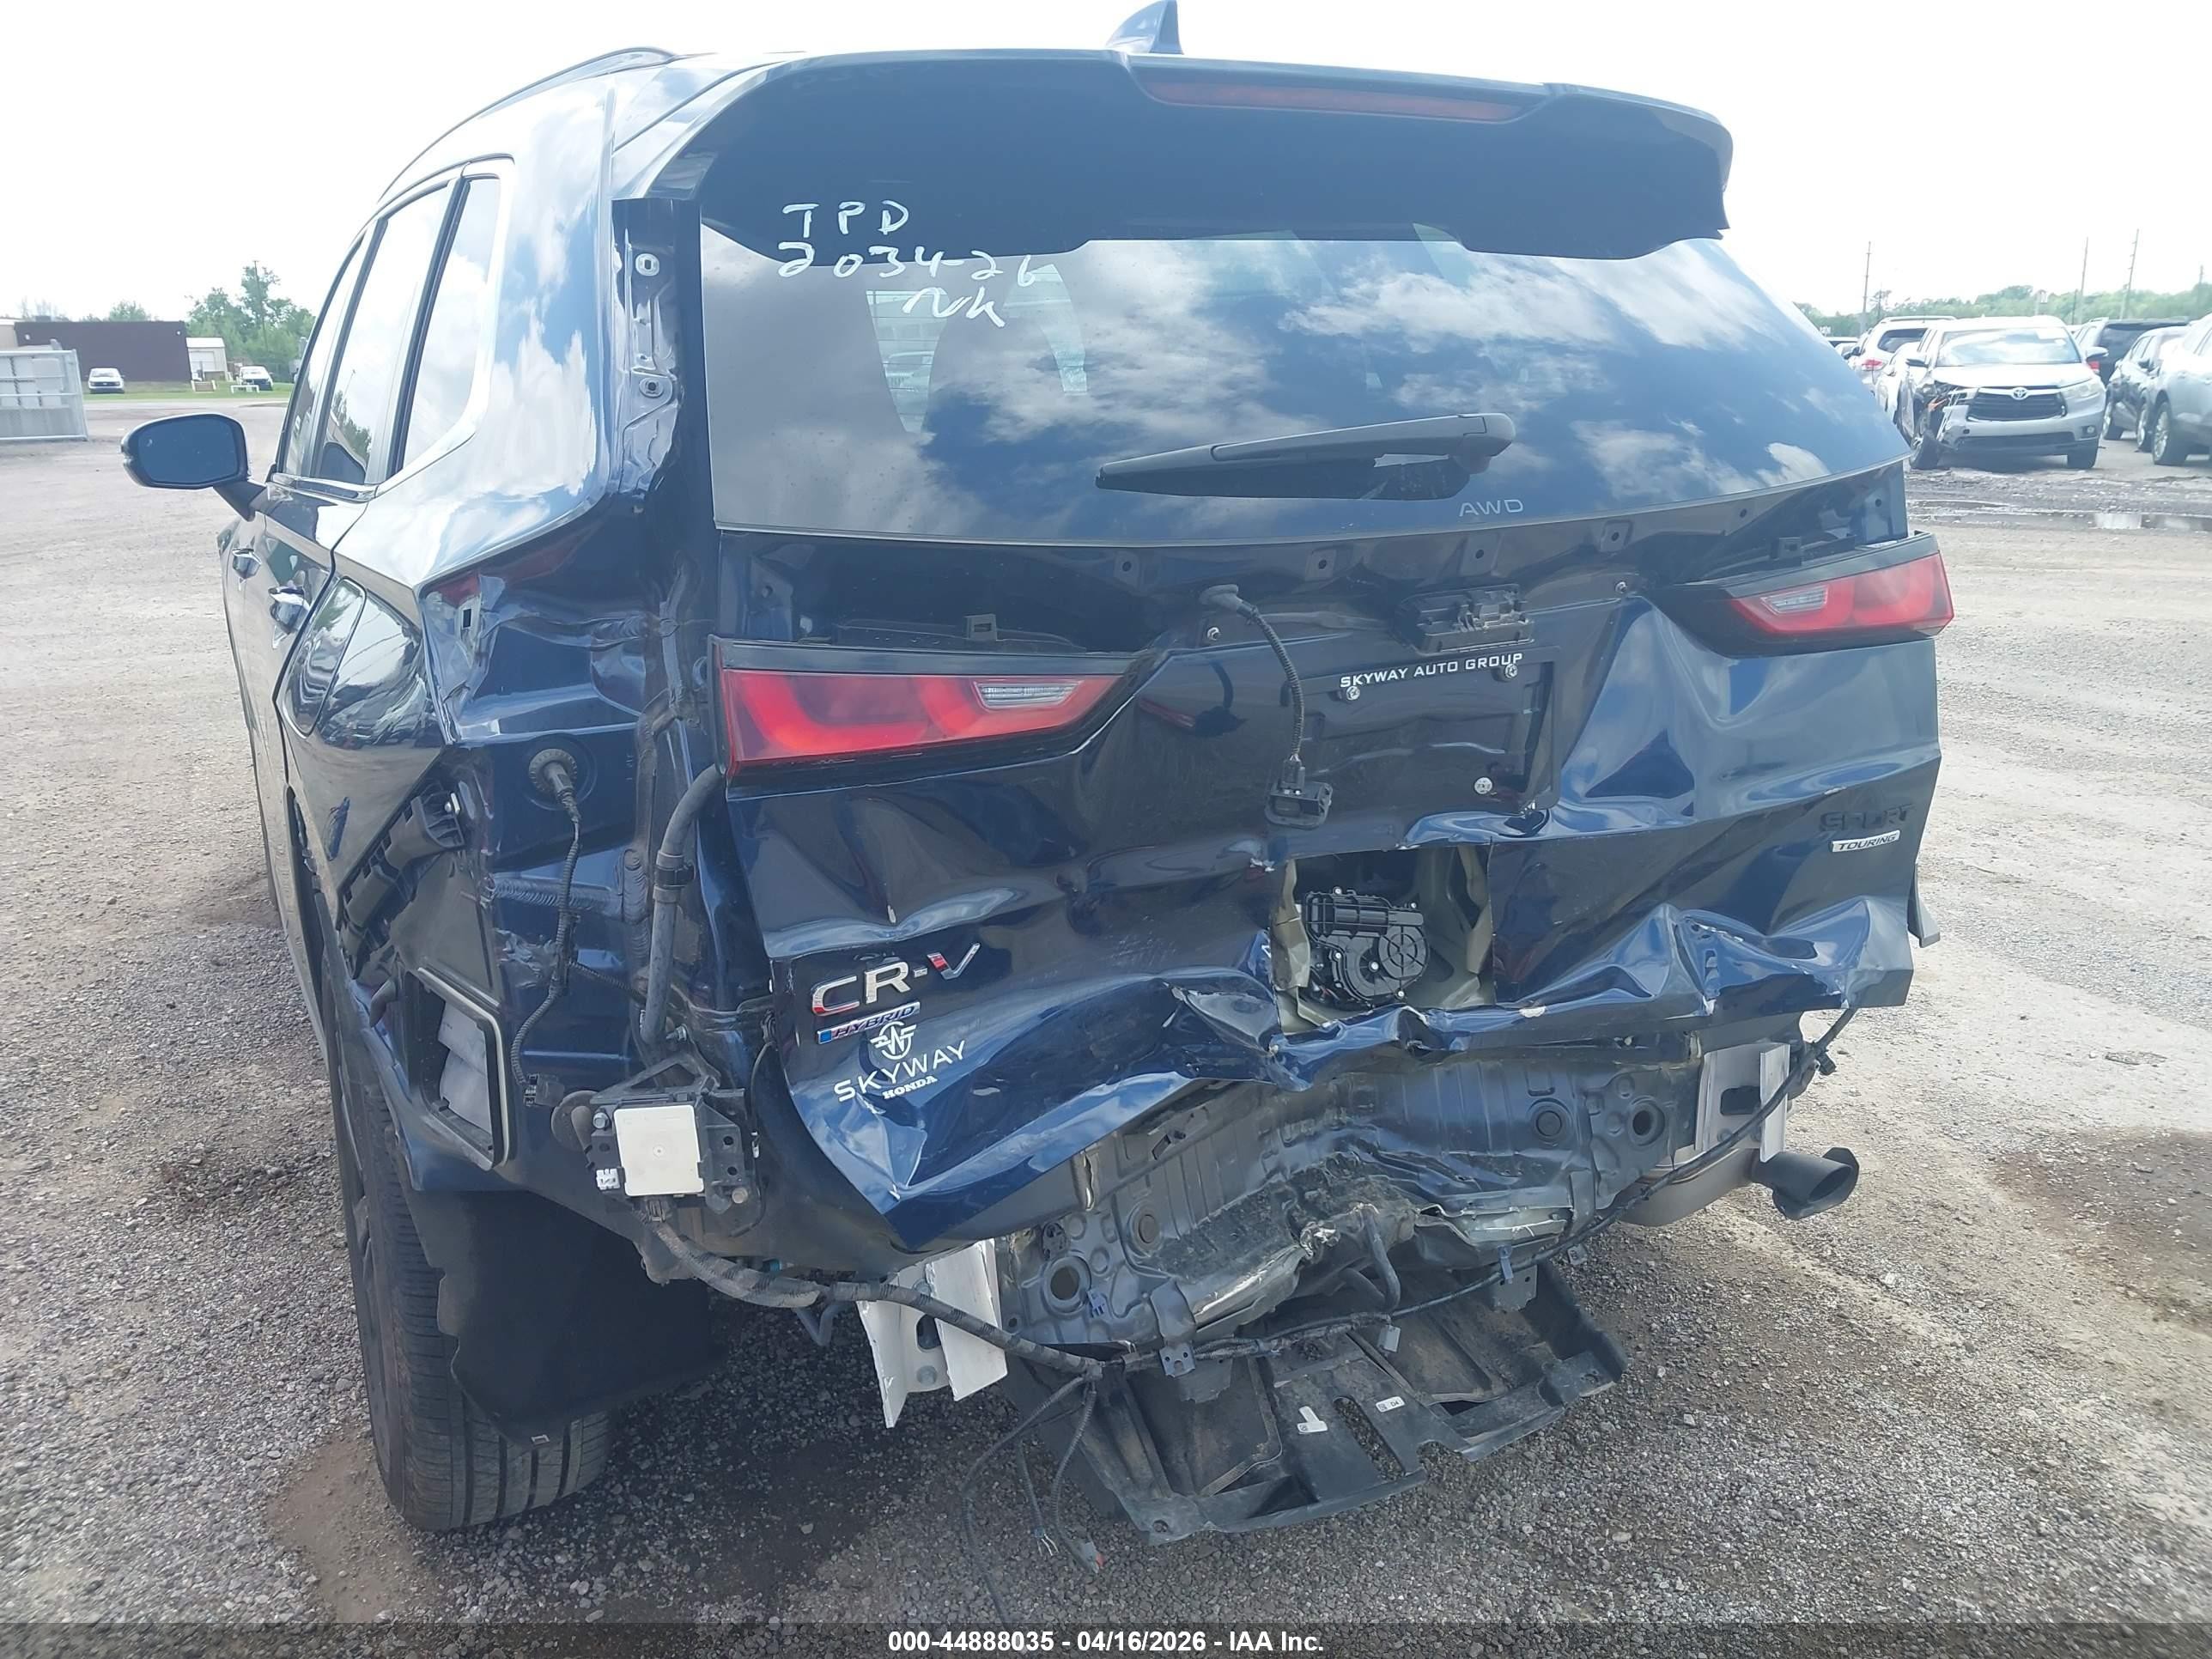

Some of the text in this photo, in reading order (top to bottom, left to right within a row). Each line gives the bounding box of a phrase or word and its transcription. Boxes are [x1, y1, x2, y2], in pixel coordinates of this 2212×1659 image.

[1459, 499, 1523, 517] AWD
[1340, 653, 1522, 688] SKYWAY AUTO GROUP
[1838, 834, 1897, 851] TOURING
[811, 942, 981, 1016] CR-V
[834, 1006, 916, 1037] HYBRID
[834, 1040, 965, 1103] SKYWAY
[882, 1075, 938, 1099] HONDA
